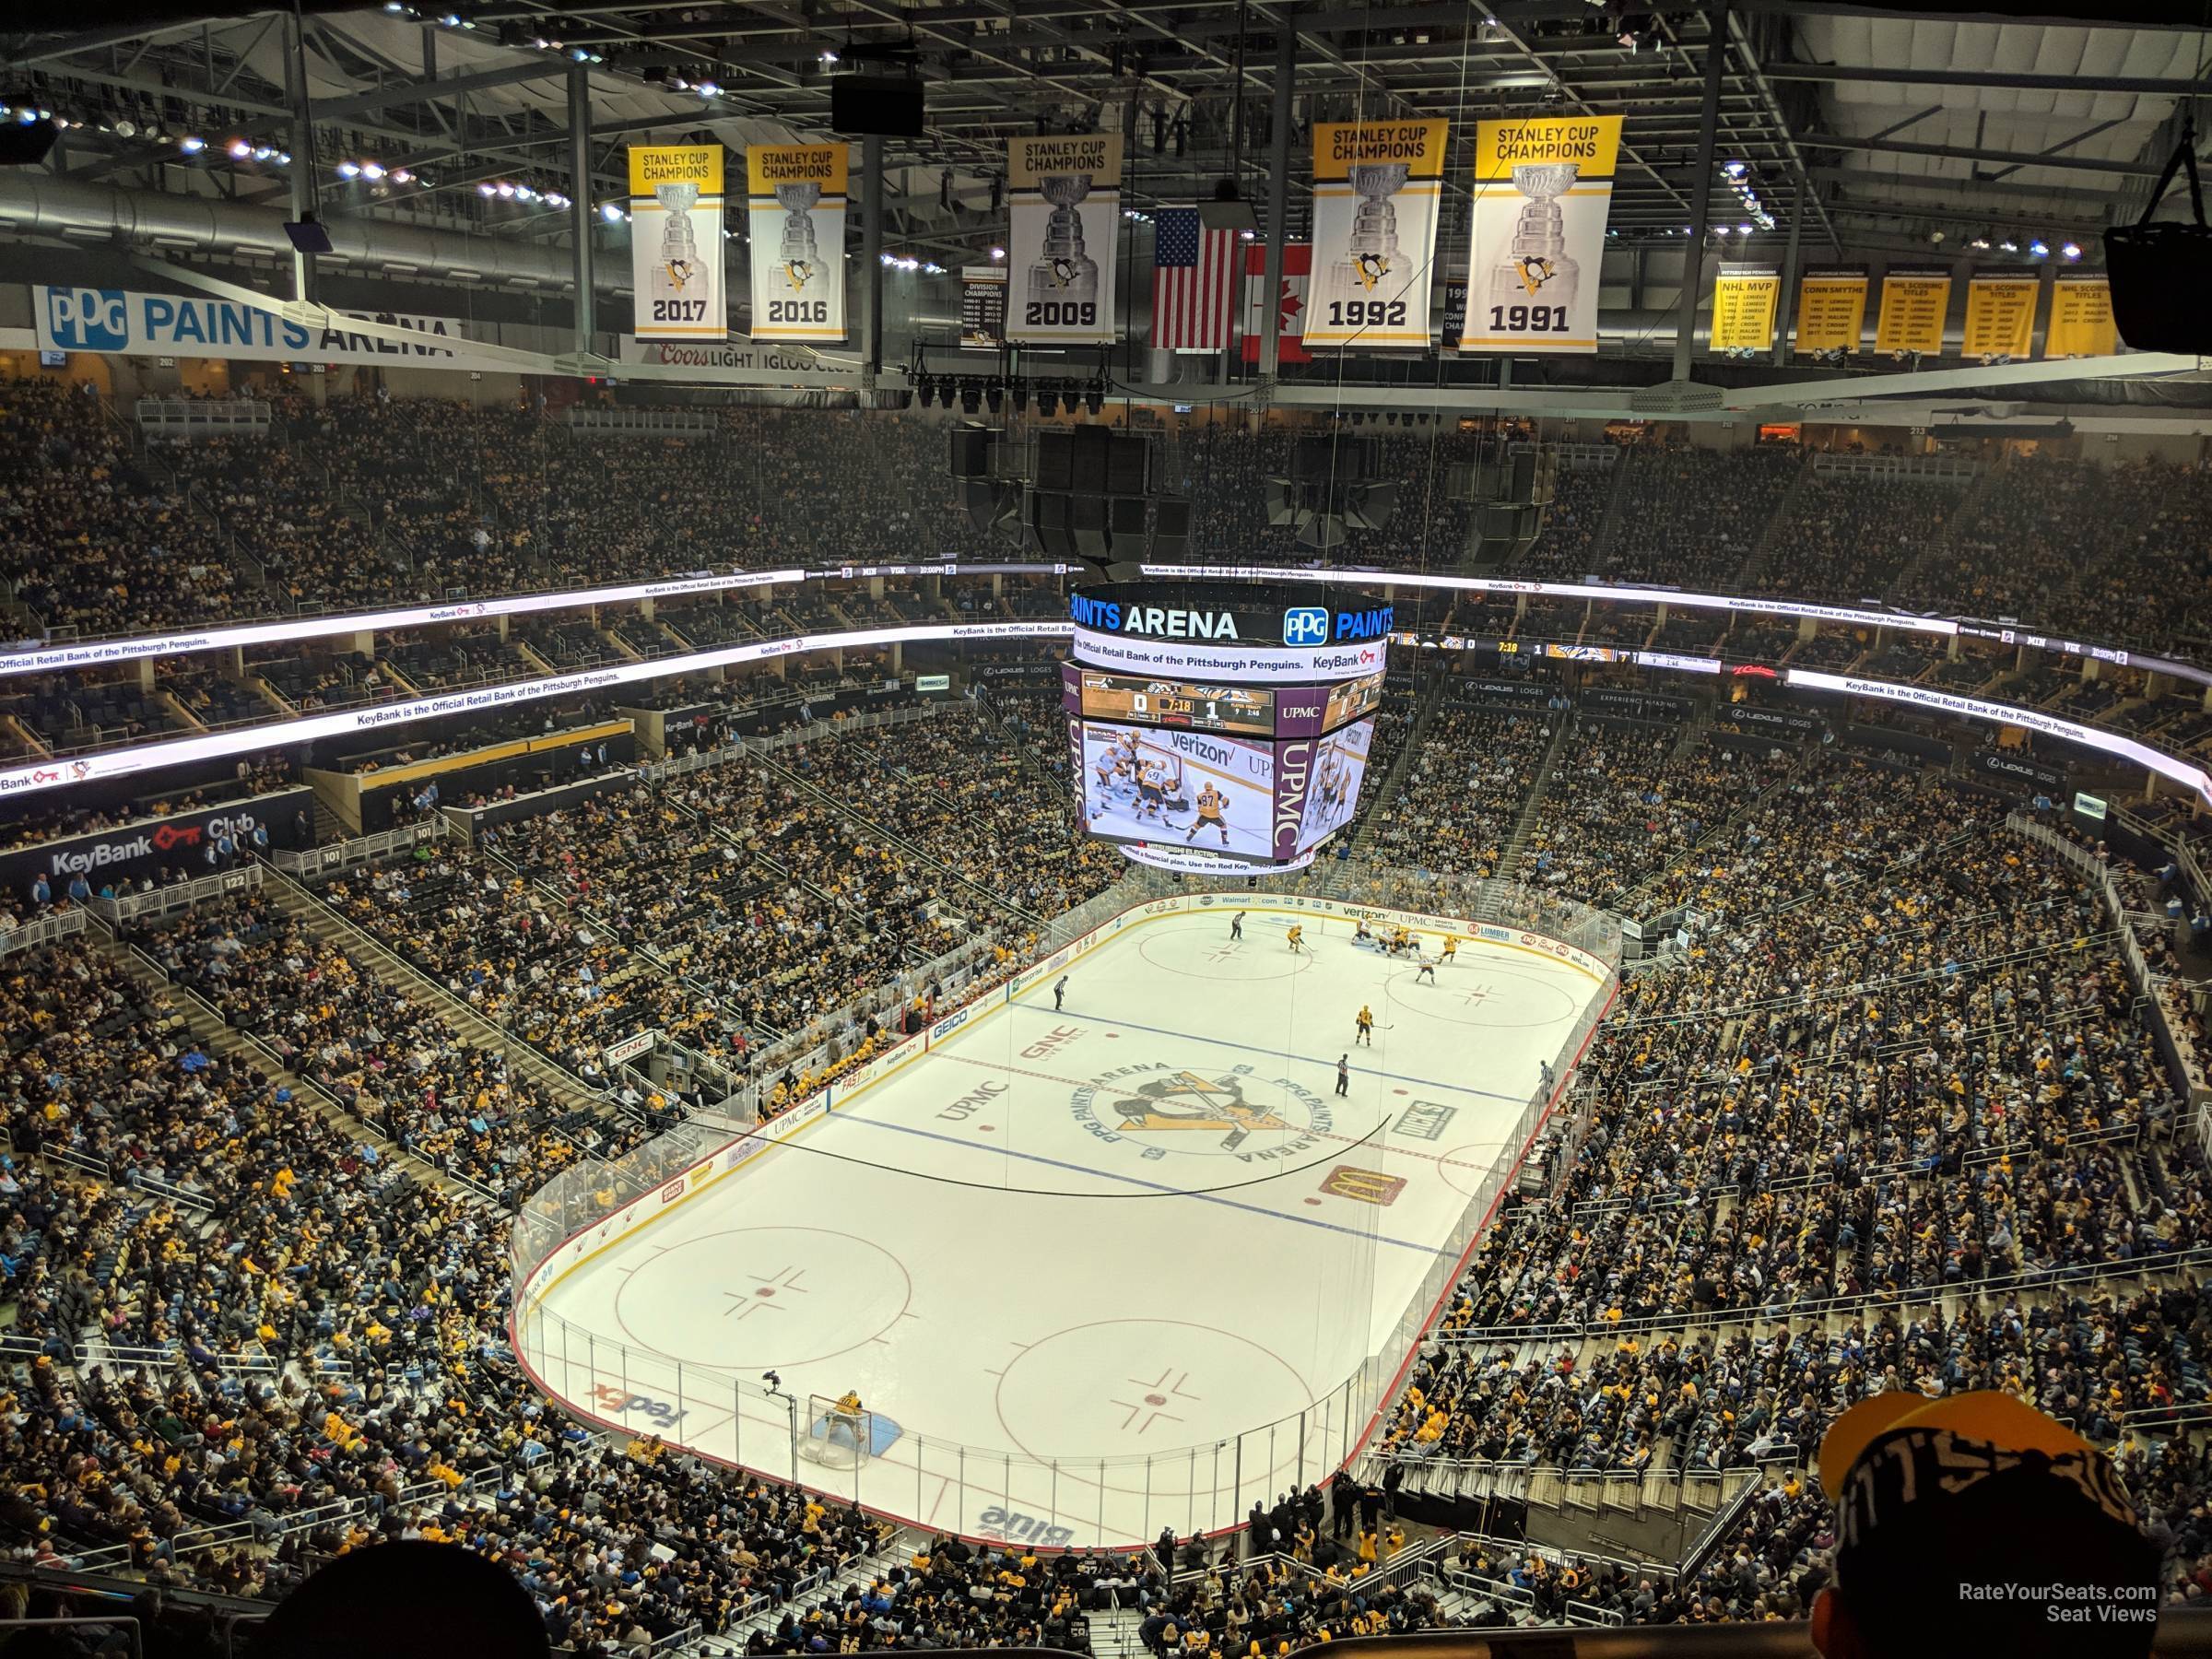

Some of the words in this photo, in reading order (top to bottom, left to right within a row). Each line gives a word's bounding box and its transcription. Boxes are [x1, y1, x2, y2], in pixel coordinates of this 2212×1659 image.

[1334, 128, 1395, 143] STANLEY
[1399, 126, 1428, 140] CUP
[1498, 128, 1564, 143] STANLEY
[1569, 126, 1599, 140] CUP
[762, 152, 808, 164] STANLEY
[811, 151, 833, 163] CUP
[1026, 142, 1079, 157] STANLEY
[1082, 141, 1106, 154] CUP
[1333, 142, 1426, 159] CHAMPIONS
[1497, 142, 1596, 159] CHAMPIONS
[643, 153, 686, 166] STANLEY
[689, 152, 709, 164] CUP
[1026, 155, 1105, 171] CHAMPIONS
[643, 166, 709, 180] CHAMPIONS
[762, 165, 833, 179] CHAMPIONS
[964, 289, 1002, 298] CHAMPIONS
[1723, 283, 1745, 291] NHL
[1747, 282, 1772, 290] MVP
[51, 288, 126, 344] PPG
[653, 300, 707, 322] 2017
[769, 300, 827, 323] 2016
[1026, 302, 1096, 325] 2009
[1328, 300, 1406, 326] 1992
[1489, 305, 1570, 332] 1991
[160, 358, 174, 367] 202
[660, 343, 710, 365] Coors
[711, 351, 753, 368] LIGHT
[313, 364, 325, 372] 203
[1488, 582, 1513, 591] KeyBank
[429, 610, 456, 618] KeyBank
[1729, 600, 1757, 608] KeyBank
[1801, 606, 1818, 615] Retail
[1819, 608, 1835, 617] Bank
[1853, 613, 1885, 623] Pittsburgh
[953, 628, 985, 636] KeyBank
[1008, 625, 1035, 633] Official
[1124, 606, 1239, 640] ARENA
[1287, 612, 1325, 641] PPG
[1336, 606, 1394, 640] PAINTS
[37, 655, 65, 665] Retail
[67, 652, 91, 661] Bank
[93, 649, 103, 657] of
[105, 648, 120, 656] the
[122, 643, 168, 655] Pittsburgh
[169, 639, 210, 650] Penguins.
[1499, 641, 1518, 653] 7:18
[1083, 641, 1101, 653] Official
[1102, 646, 1124, 658] Retail
[1126, 651, 1150, 662] Bank
[1153, 654, 1164, 663] of
[1166, 655, 1183, 665] the
[1186, 656, 1246, 670] Pittsburgh
[1250, 659, 1304, 671] Penguins.
[1313, 653, 1359, 670] KeyBank
[1065, 681, 1079, 697] UPMC
[1520, 688, 1544, 696] LOGES
[358, 711, 401, 726] KeyBank
[404, 708, 412, 716] is
[415, 705, 430, 715] the
[432, 699, 465, 712] Official
[467, 695, 492, 706] Retail
[495, 690, 515, 701] Bank
[518, 687, 526, 696] of
[528, 685, 541, 694] the
[543, 678, 582, 692] Pittsburgh
[584, 673, 619, 686] Penguins.
[1135, 694, 1147, 712] 0
[1169, 699, 1191, 711] 7:18
[1206, 701, 1218, 719] 1
[1282, 706, 1321, 719] UPMC
[1845, 680, 1885, 694] KeyBank
[1898, 688, 1912, 698] the
[1913, 691, 1940, 705] Official
[1942, 698, 1965, 711] Retail
[1968, 702, 1988, 714] Bank
[1990, 708, 1999, 716] of
[2000, 709, 2014, 719] the
[2016, 712, 2057, 730] Pittsburgh
[2053, 723, 2086, 739] Penguins.
[1747, 713, 1783, 724] LEXUS
[1788, 720, 1813, 729] LOGES
[1171, 731, 1229, 767] verizon
[665, 765, 677, 775] 103
[1069, 719, 1085, 819] UPMC
[2000, 764, 2034, 776] LEXUS
[1202, 794, 1214, 807] 87
[1275, 743, 1310, 848] UPMC
[418, 828, 431, 840] 101
[53, 836, 153, 876] KeyBank
[207, 813, 255, 838] Club
[324, 850, 340, 864] 101
[1188, 860, 1203, 868] Use
[1234, 862, 1250, 871] Key.
[226, 876, 244, 889] 122
[1344, 906, 1386, 920] verizon
[1399, 913, 1431, 927] UPMC
[1480, 926, 1510, 939] LUMBER
[934, 1009, 968, 1039] GEICO
[615, 1036, 649, 1058] GNC
[1020, 1025, 1078, 1059] GNC
[1090, 1062, 1171, 1087] ARENA
[1273, 1077, 1311, 1100] PPG
[935, 1081, 1009, 1124] UPMC
[1070, 1087, 1093, 1122] PAINTS
[774, 1109, 802, 1135] UPMC
[1307, 1097, 1335, 1134] PAINTS
[1086, 1123, 1123, 1145] PPG
[1234, 1134, 1321, 1164] ARENA
[584, 1383, 689, 1429] FedEx
[980, 1505, 1075, 1547] Blue
